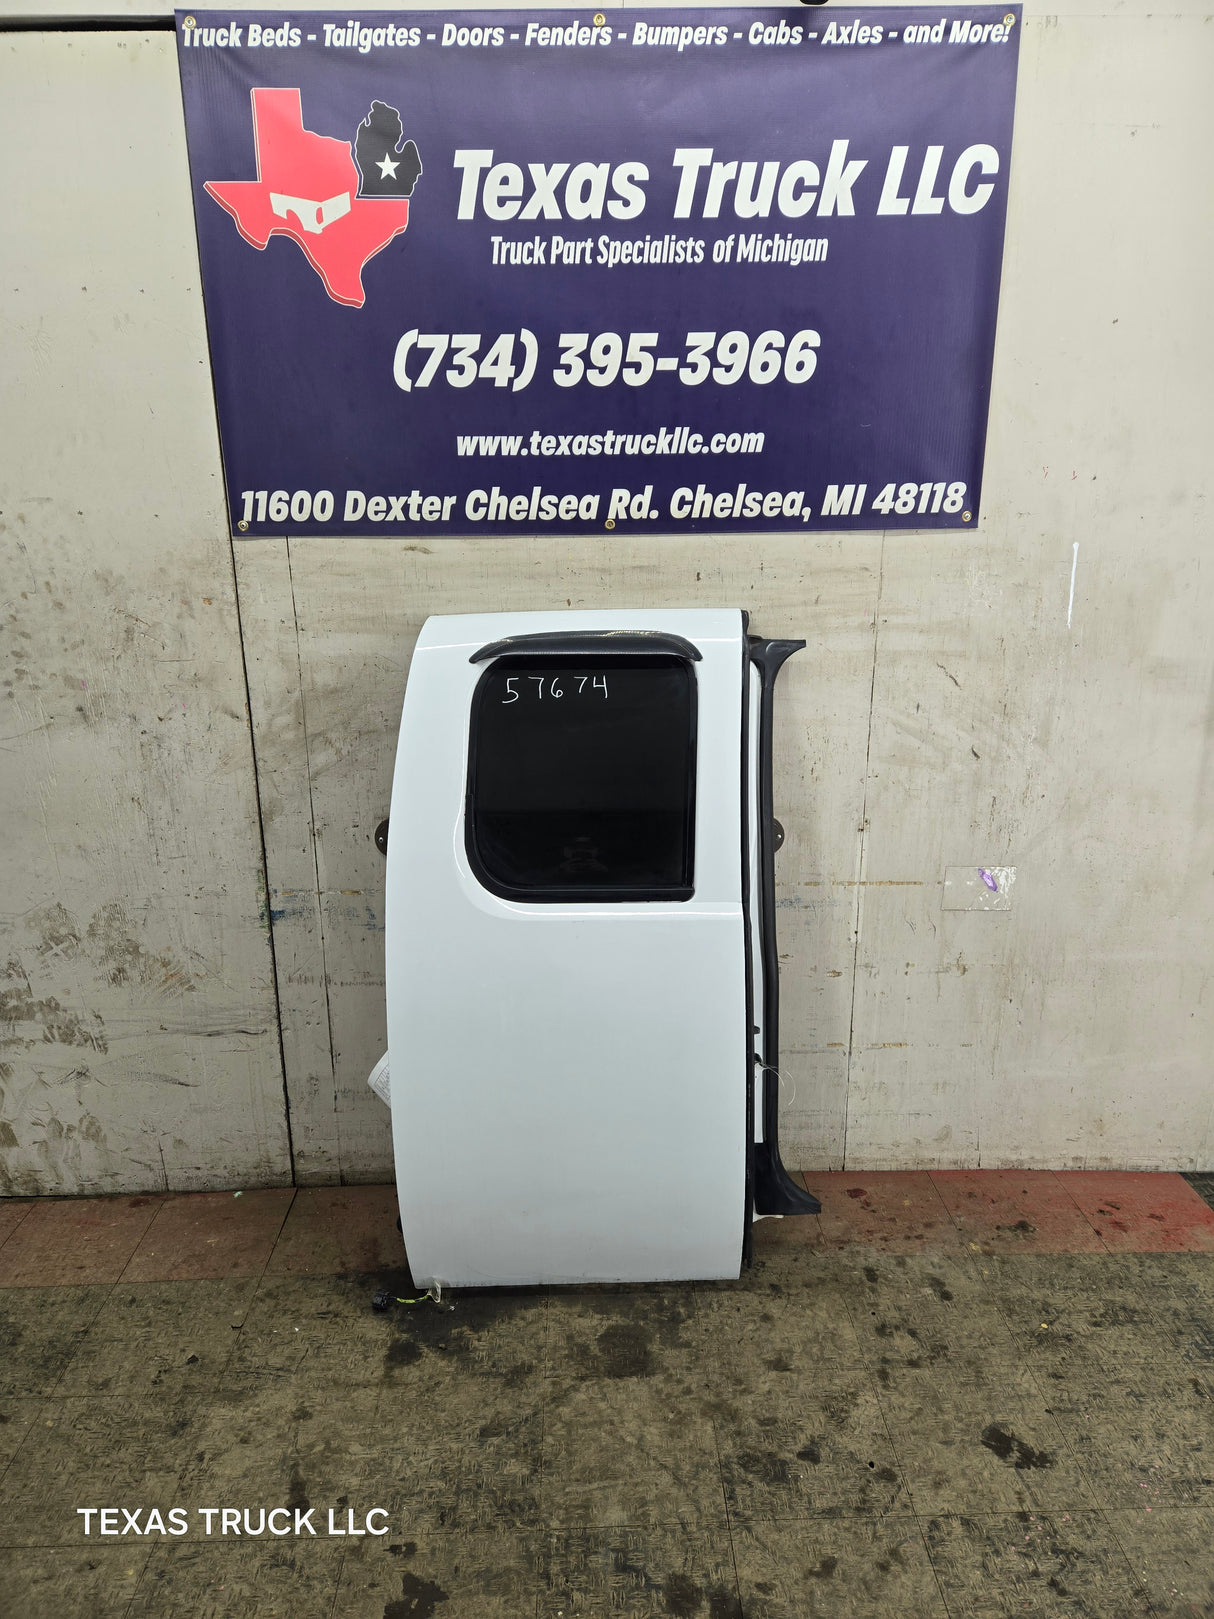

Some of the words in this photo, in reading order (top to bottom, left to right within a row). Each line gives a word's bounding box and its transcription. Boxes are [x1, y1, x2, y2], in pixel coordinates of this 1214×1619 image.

[182, 22, 242, 48] Truck
[248, 22, 302, 47] Beds
[322, 21, 422, 54] Tailgates
[441, 21, 505, 47] Doors
[525, 20, 612, 46] Fenders
[632, 21, 728, 51] Bumpers
[748, 19, 803, 45] Cabs
[821, 19, 883, 45] Axles
[903, 18, 947, 43] and
[949, 19, 1011, 43] More!
[453, 149, 649, 220] Texas
[672, 139, 869, 219] Truck
[876, 143, 1000, 217] LLC
[490, 235, 547, 265] Truck
[550, 235, 593, 265] Part
[597, 234, 705, 267] Specialists
[712, 234, 736, 263] of
[736, 233, 829, 266] Michigan
[393, 328, 538, 392] (734)
[552, 329, 821, 388] 395-3966
[456, 427, 765, 456] www.texastruckllc.com
[241, 489, 334, 522] 11600
[343, 489, 456, 522] Dexter
[465, 486, 600, 520] Chelsea
[608, 484, 659, 520] Rd.
[669, 483, 811, 522] Chelsea,
[821, 484, 870, 516] MI
[871, 481, 967, 514] 48118
